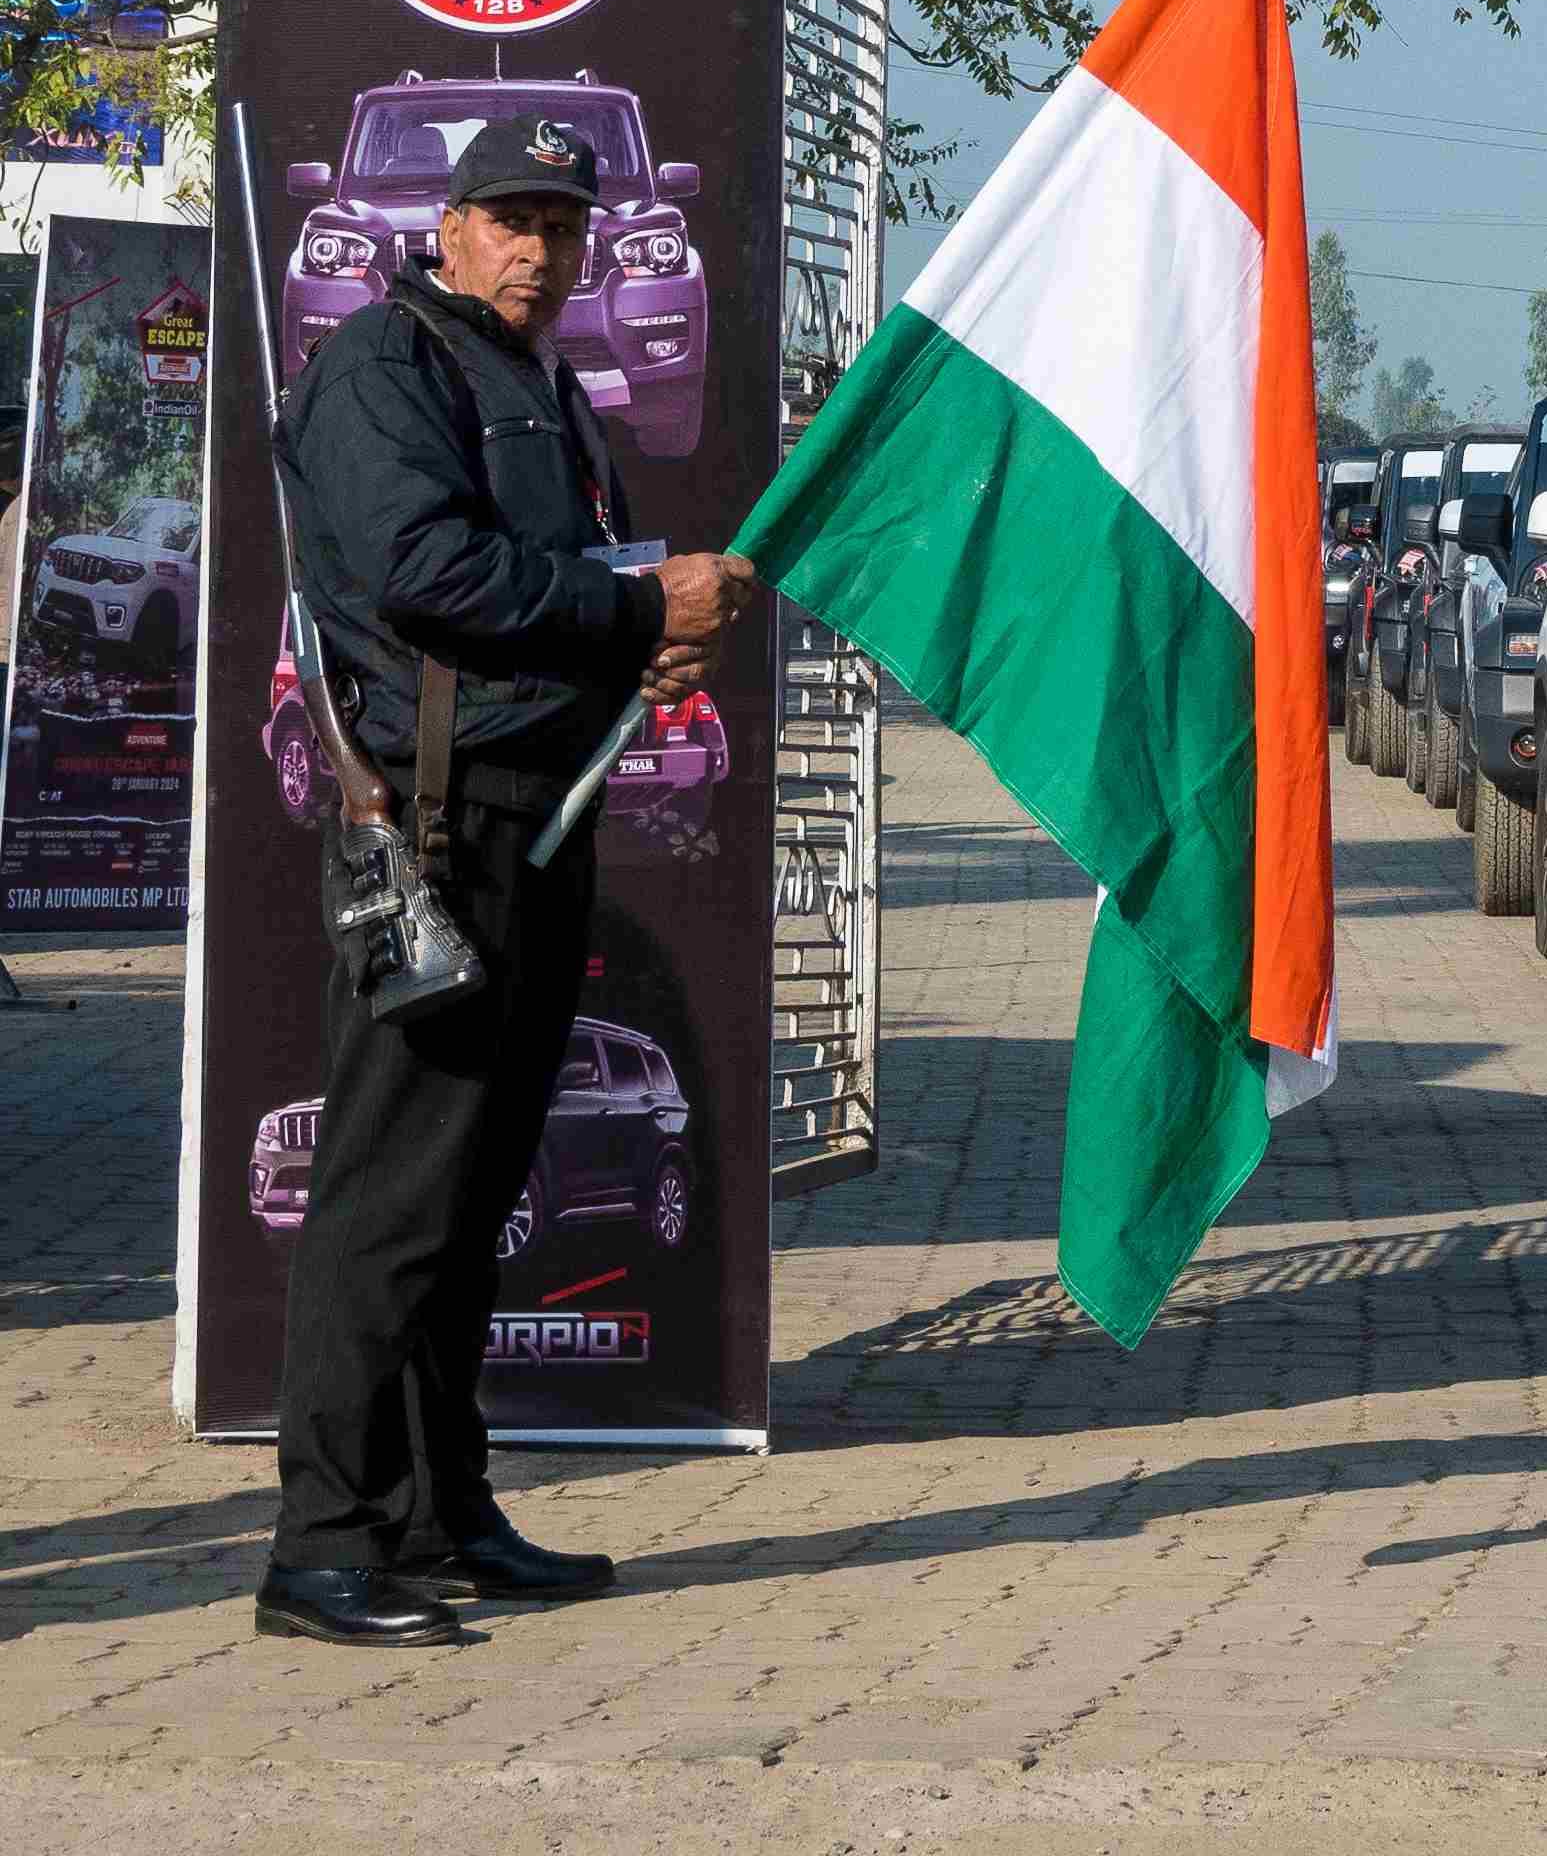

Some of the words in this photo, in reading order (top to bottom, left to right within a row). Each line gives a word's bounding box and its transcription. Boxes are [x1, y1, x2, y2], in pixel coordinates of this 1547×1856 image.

[147, 329, 206, 347] ESCAPE
[619, 758, 656, 773] THAR
[8, 888, 41, 910] STAR
[45, 887, 138, 910] AUTOMOBILES
[142, 887, 163, 909] MP
